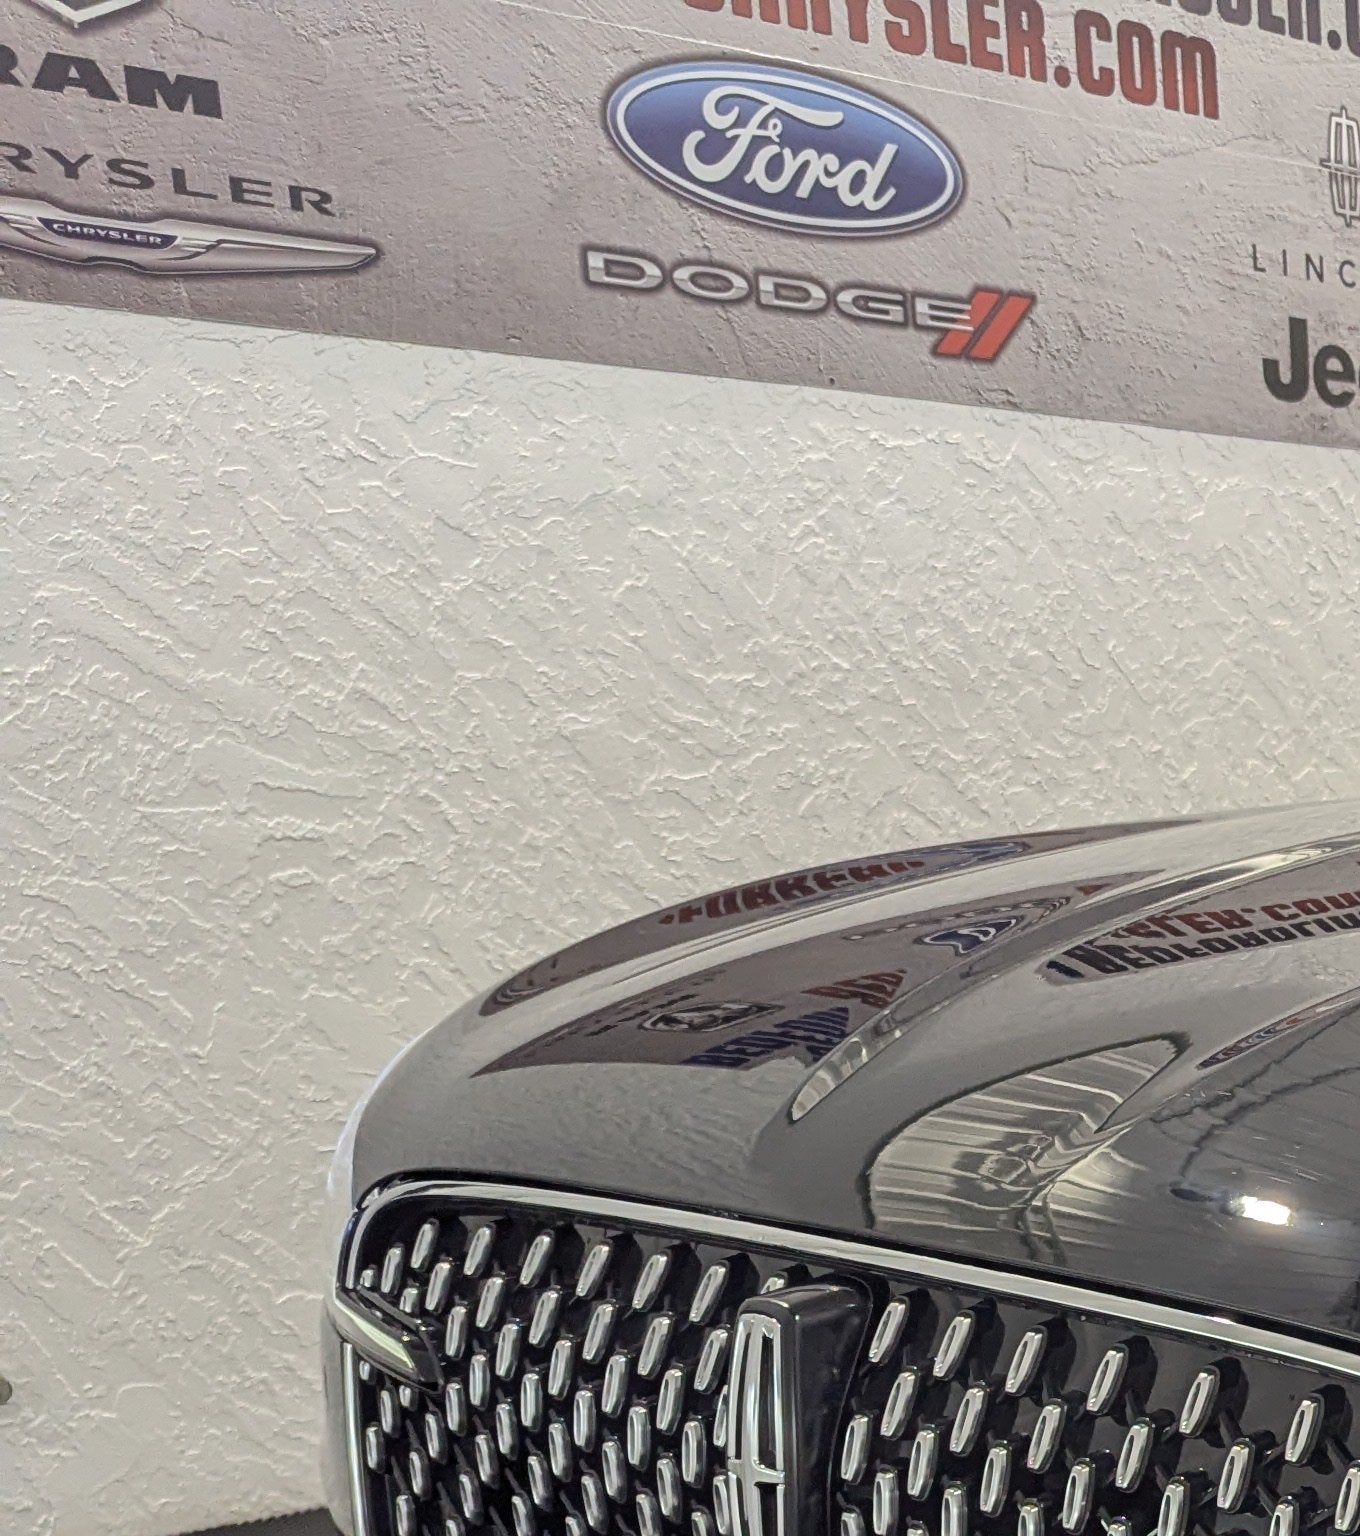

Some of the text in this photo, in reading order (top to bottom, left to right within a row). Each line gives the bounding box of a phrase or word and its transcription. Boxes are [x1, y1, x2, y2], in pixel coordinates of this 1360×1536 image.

[682, 84, 897, 212] Ford
[52, 222, 163, 246] CHRYSLER
[588, 250, 976, 332] DODGE
